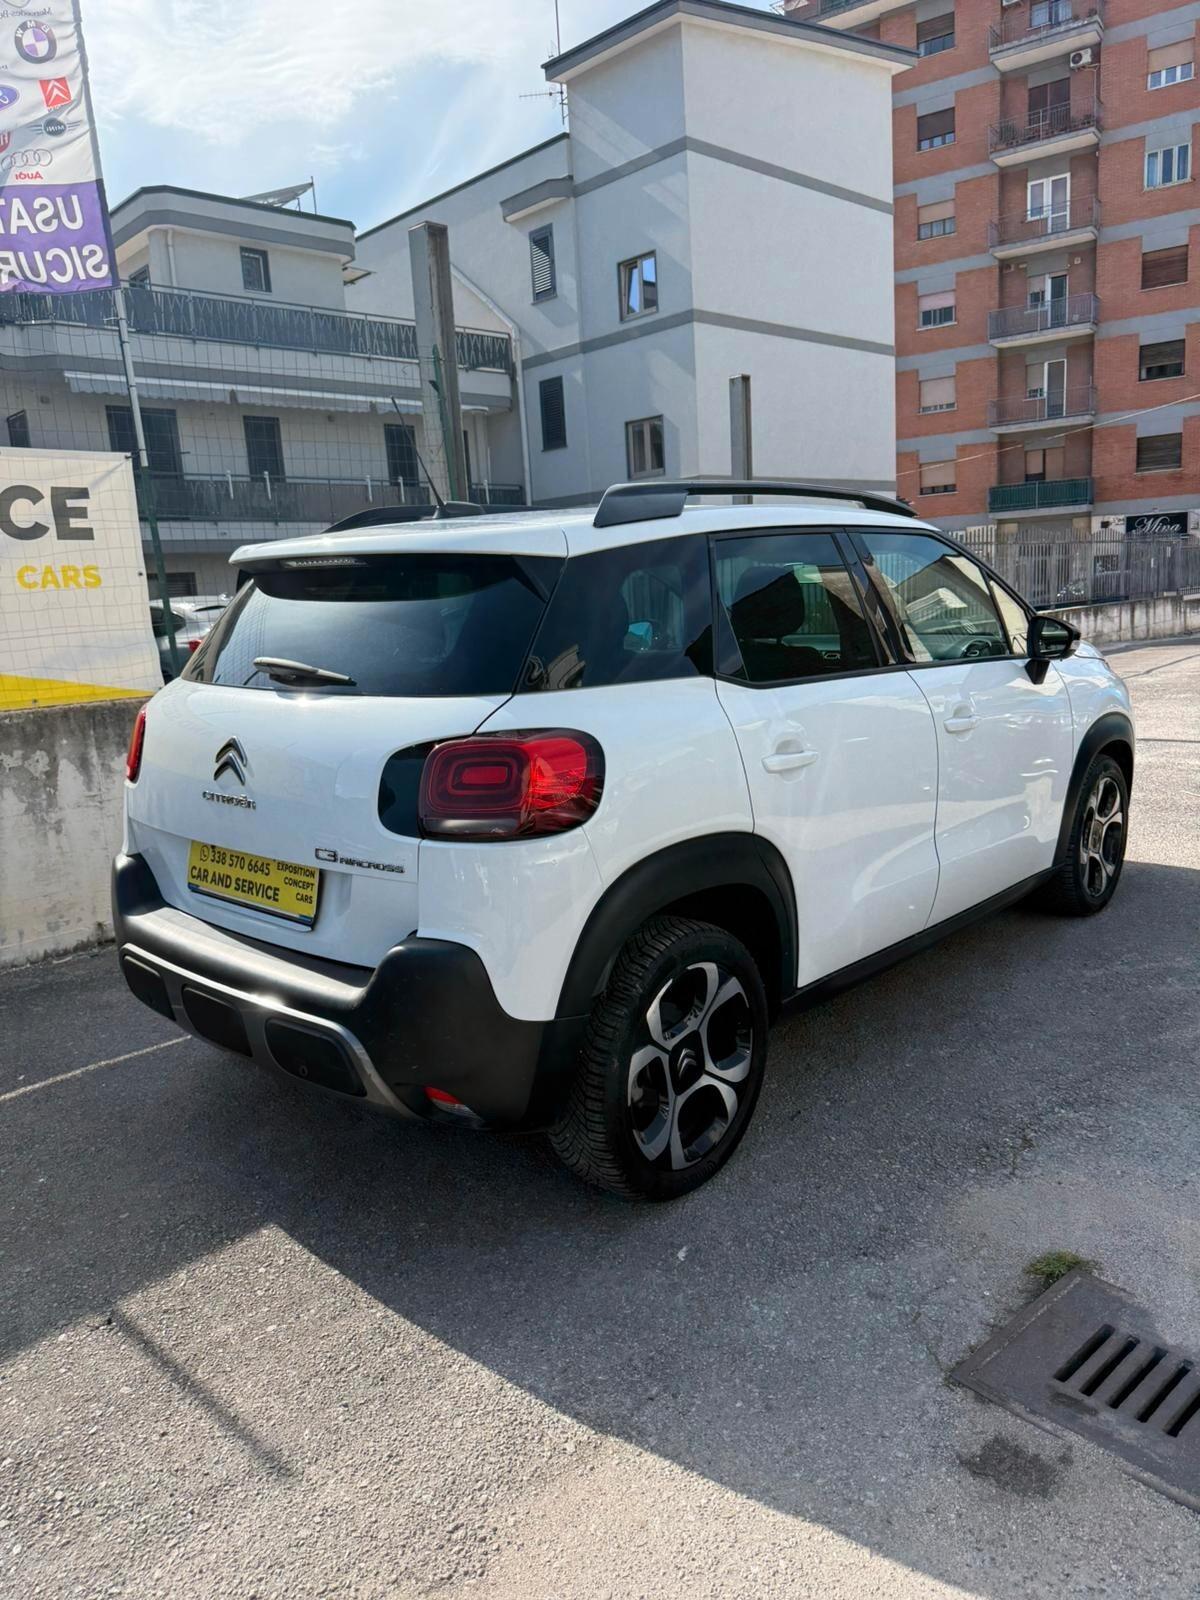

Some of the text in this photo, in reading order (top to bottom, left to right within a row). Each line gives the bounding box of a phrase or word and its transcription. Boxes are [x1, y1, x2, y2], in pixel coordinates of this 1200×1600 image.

[0, 485, 95, 541] CE
[16, 564, 102, 589] CARS
[210, 849, 271, 877] 338 570 6645
[315, 848, 338, 862] C3
[276, 862, 316, 879] EXPOSITION
[190, 865, 280, 903] CAR AND SERVICE
[283, 876, 315, 892] CONCEPT
[295, 892, 313, 905] CARS
